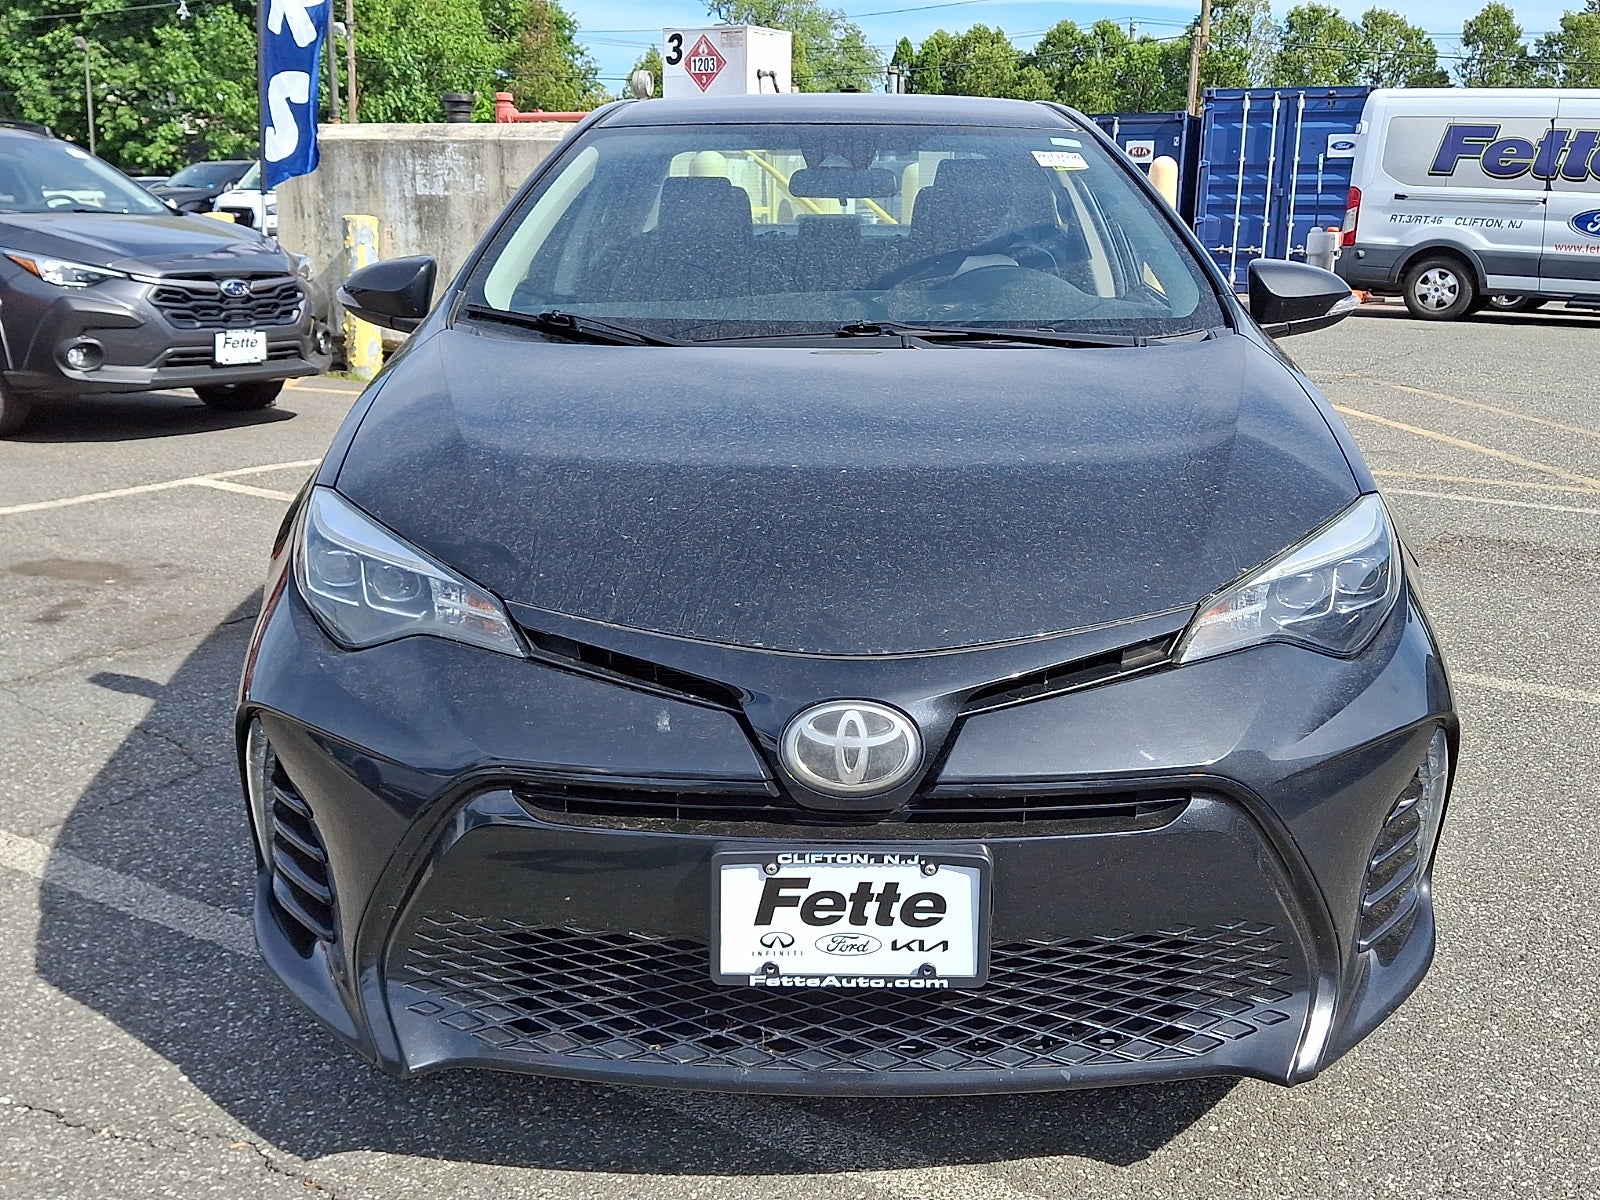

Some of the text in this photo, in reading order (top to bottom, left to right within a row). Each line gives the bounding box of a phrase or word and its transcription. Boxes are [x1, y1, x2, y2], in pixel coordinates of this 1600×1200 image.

[666, 33, 683, 65] 3
[692, 57, 716, 72] 1203
[701, 75, 707, 84] 3
[1131, 147, 1148, 156] KIA
[1428, 123, 1600, 182] Fett
[1389, 214, 1523, 229] RT.3/RT.46 CLIFTON, NJ
[223, 337, 258, 349] Fette
[777, 853, 926, 865] CLIFTON, N.J.
[754, 877, 947, 928] Fette
[825, 935, 949, 953] Ford KIA
[749, 974, 949, 989] FetteAuto.com
